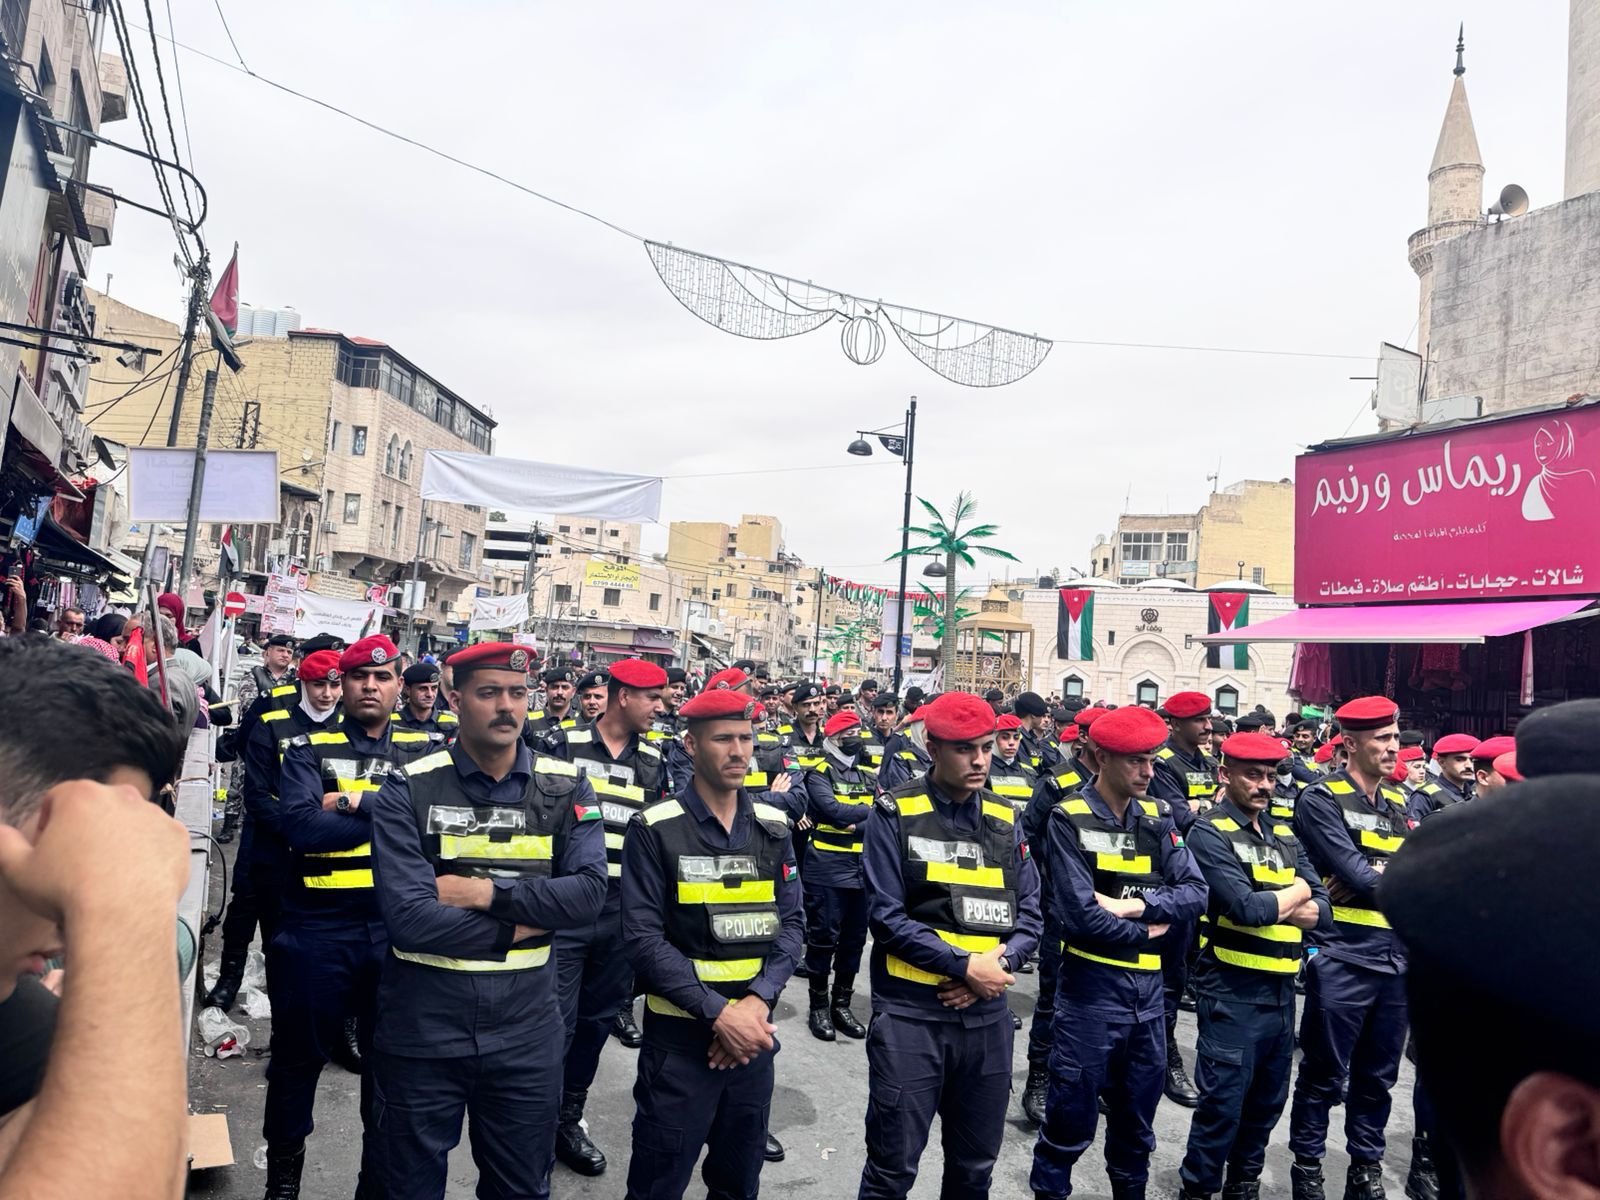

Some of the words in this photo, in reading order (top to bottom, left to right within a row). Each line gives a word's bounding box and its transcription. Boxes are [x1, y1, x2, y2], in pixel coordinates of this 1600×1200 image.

[1402, 439, 1522, 507] ريماس
[1372, 577, 1405, 596] صلاة
[1455, 572, 1519, 596] حجابات
[1531, 564, 1584, 587] شالات
[964, 901, 1010, 924] POLICE
[724, 917, 771, 937] POLICE
